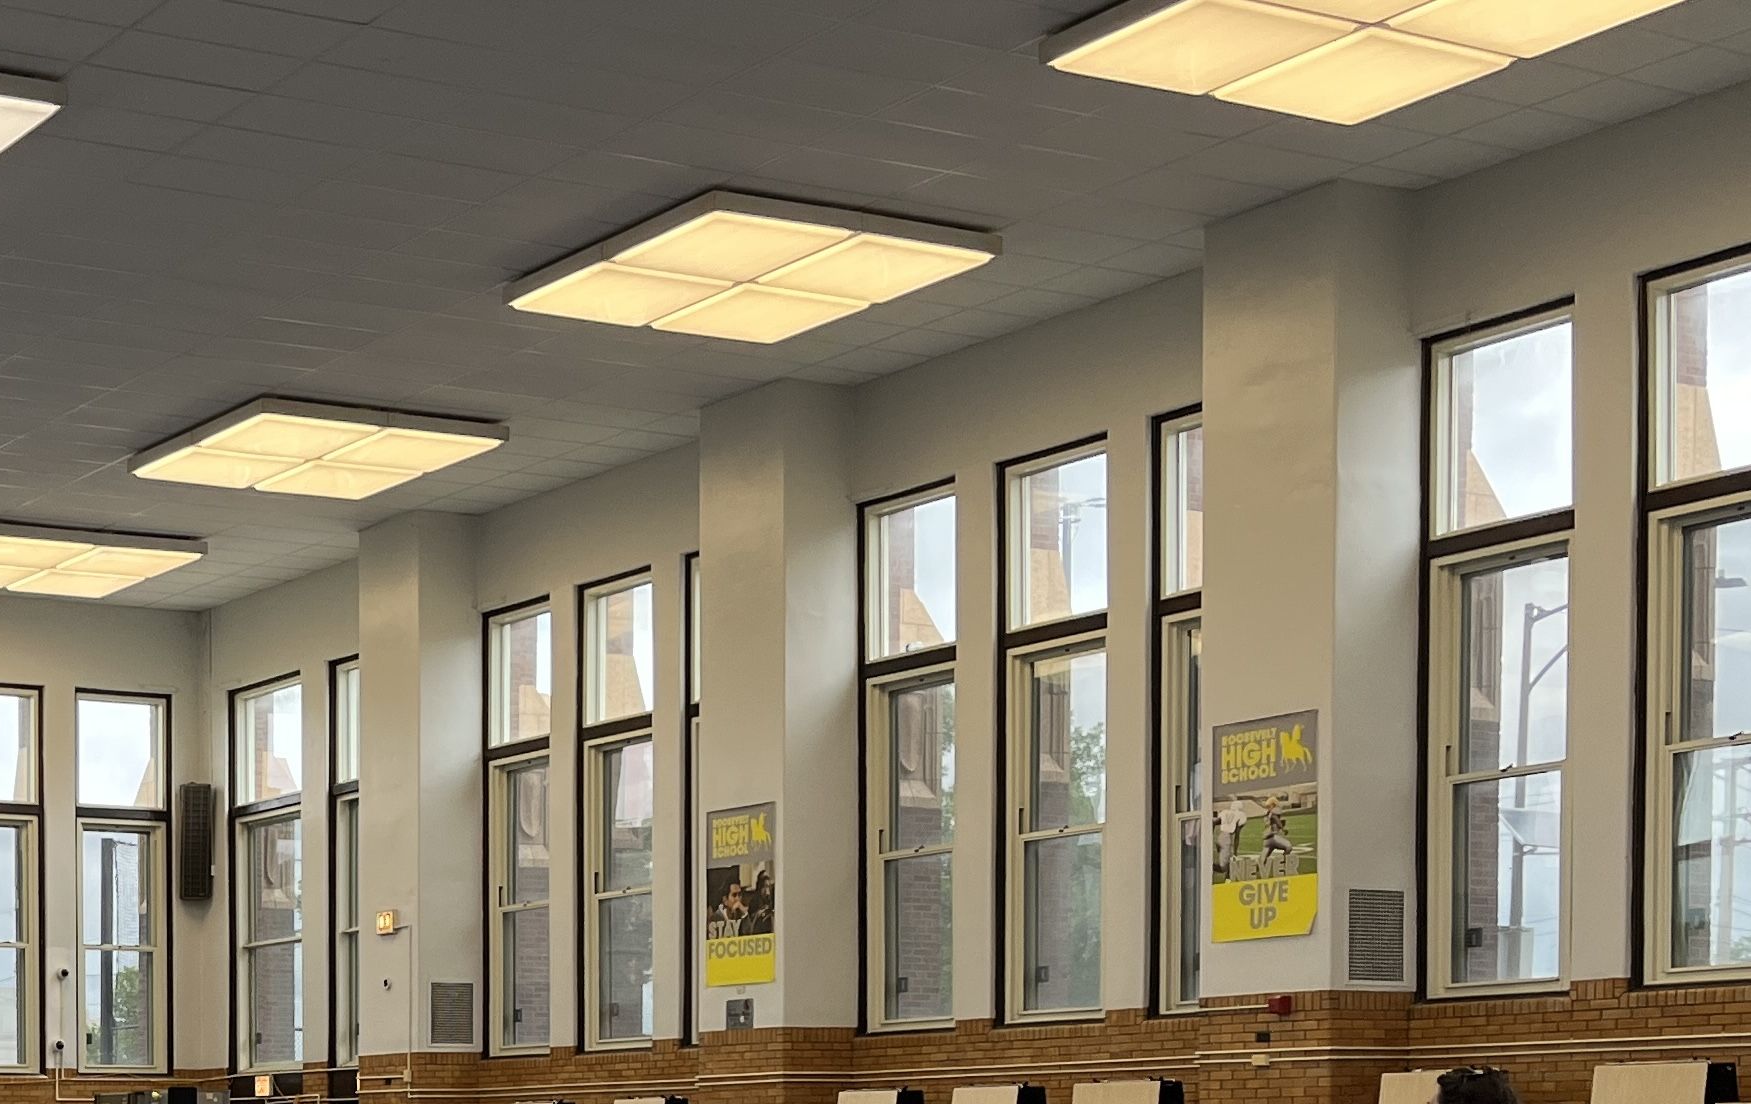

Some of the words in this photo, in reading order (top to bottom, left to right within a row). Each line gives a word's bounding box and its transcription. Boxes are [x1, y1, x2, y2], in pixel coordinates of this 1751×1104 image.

[1221, 727, 1277, 747] ROOSEVELT
[1221, 738, 1276, 770] HIGH
[1221, 761, 1276, 784] SCHOOL
[712, 823, 749, 848] HIGH
[712, 843, 749, 859] SCHOOL
[1229, 853, 1299, 882] NEVER
[1238, 880, 1289, 906] GIVE
[708, 919, 742, 940] STAY
[1249, 907, 1277, 930] UP
[708, 937, 773, 960] FOCUSED
